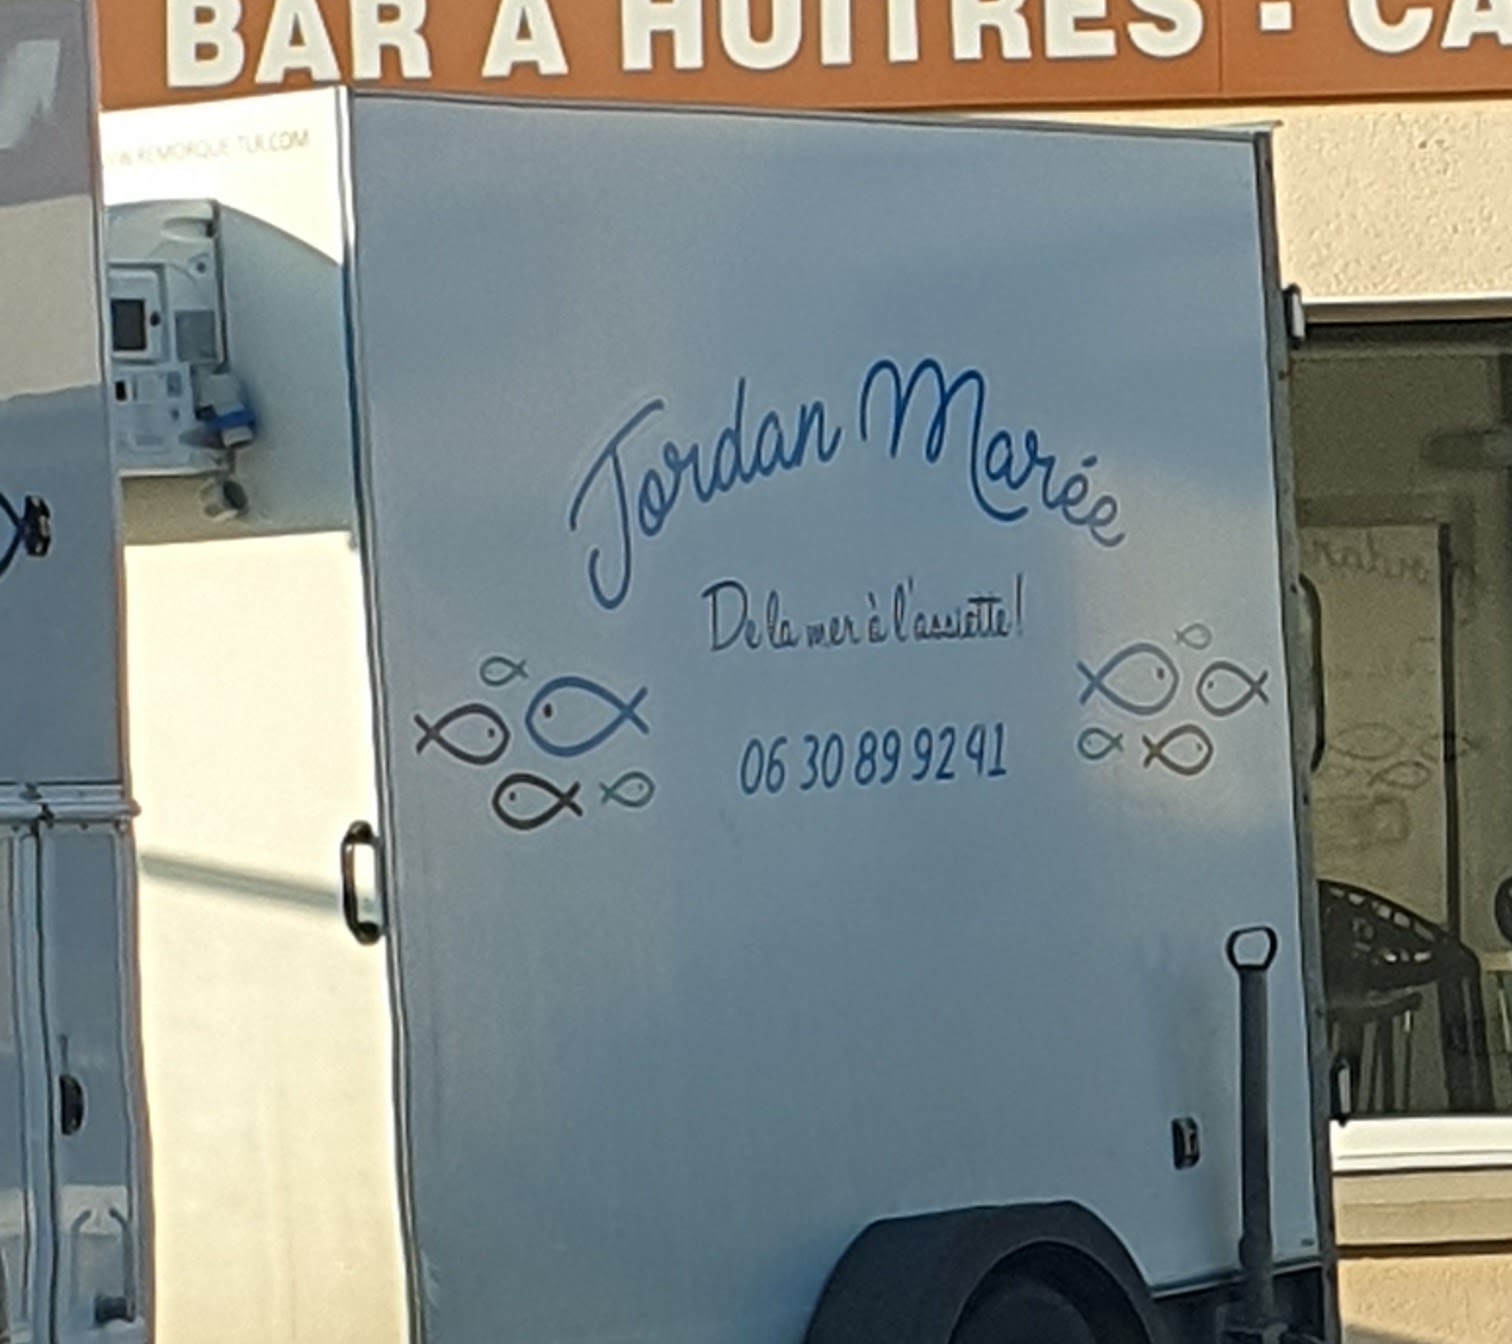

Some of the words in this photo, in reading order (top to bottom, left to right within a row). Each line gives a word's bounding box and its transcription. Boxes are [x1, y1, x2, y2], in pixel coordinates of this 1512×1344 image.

[570, 377, 841, 610] Jordan
[860, 358, 1125, 547] Marée
[806, 612, 860, 648] mer
[867, 591, 888, 644] à
[740, 736, 788, 795] 06
[800, 732, 845, 791] 30
[854, 728, 901, 786] 89
[911, 725, 956, 781] 92
